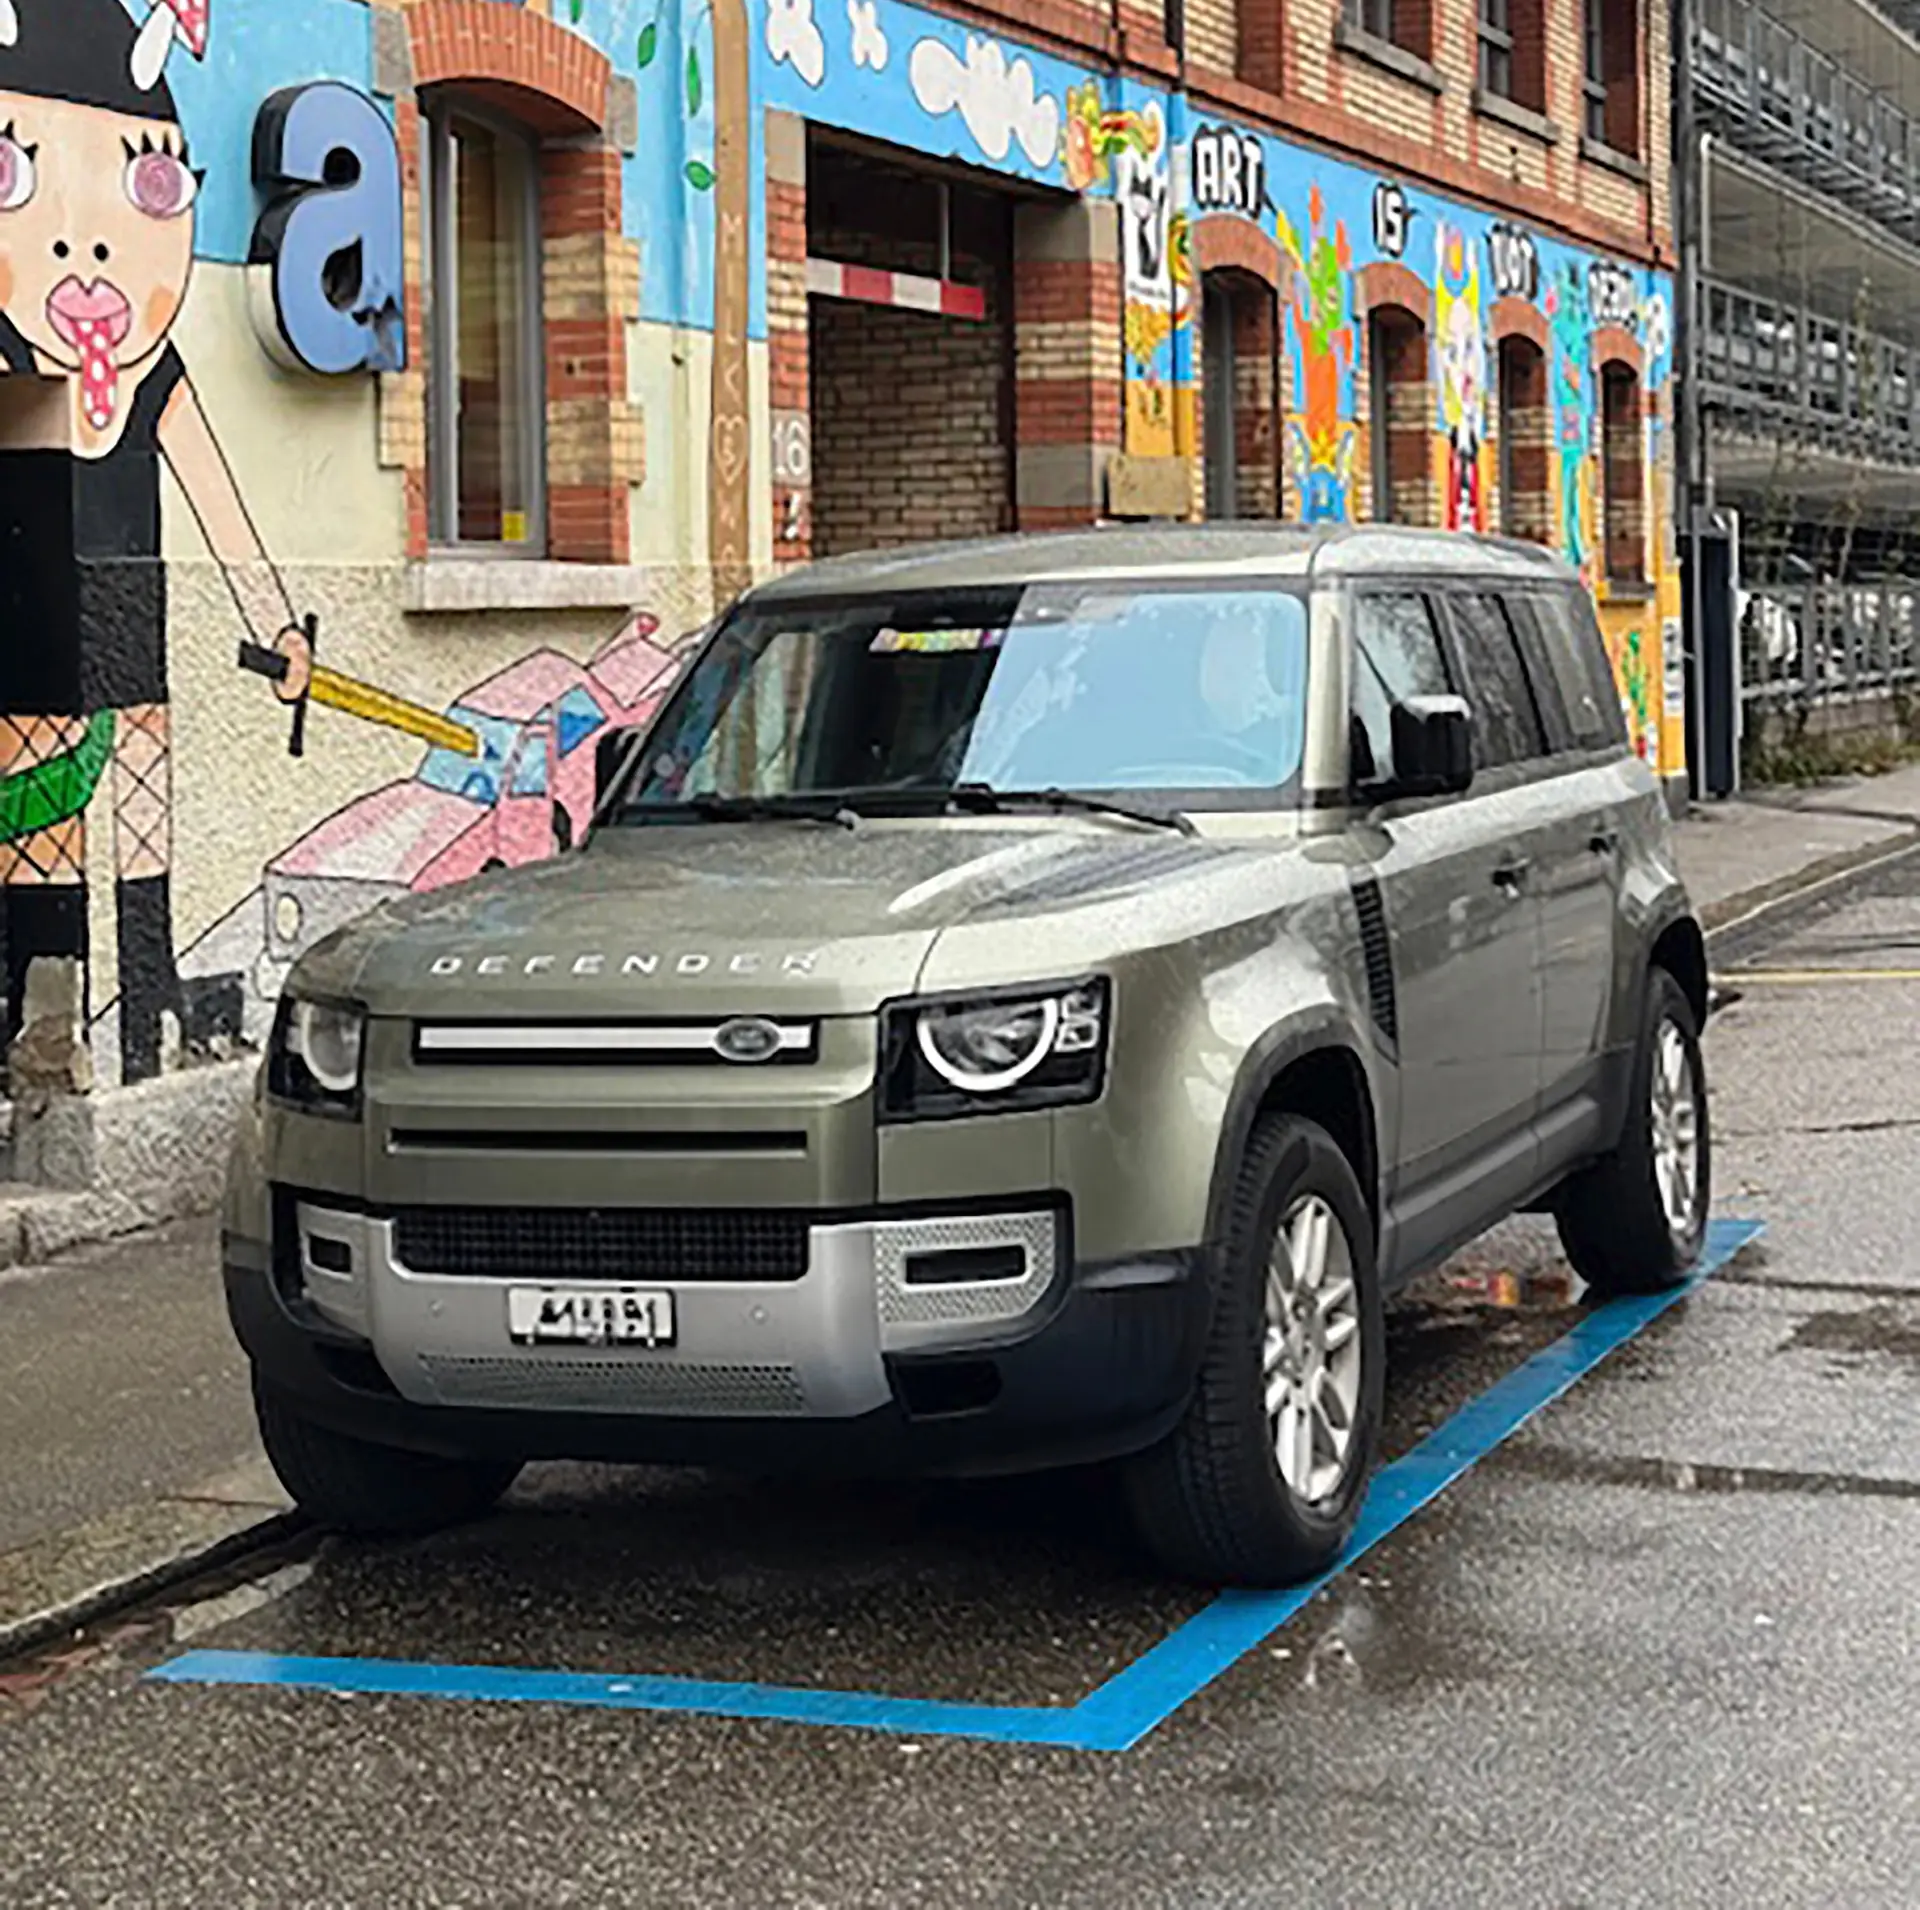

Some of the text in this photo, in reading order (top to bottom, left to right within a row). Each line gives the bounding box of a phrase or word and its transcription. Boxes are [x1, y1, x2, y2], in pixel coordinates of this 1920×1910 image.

[1193, 127, 1264, 216] ART
[1374, 184, 1408, 257] IS
[431, 954, 817, 974] DEFENDER
